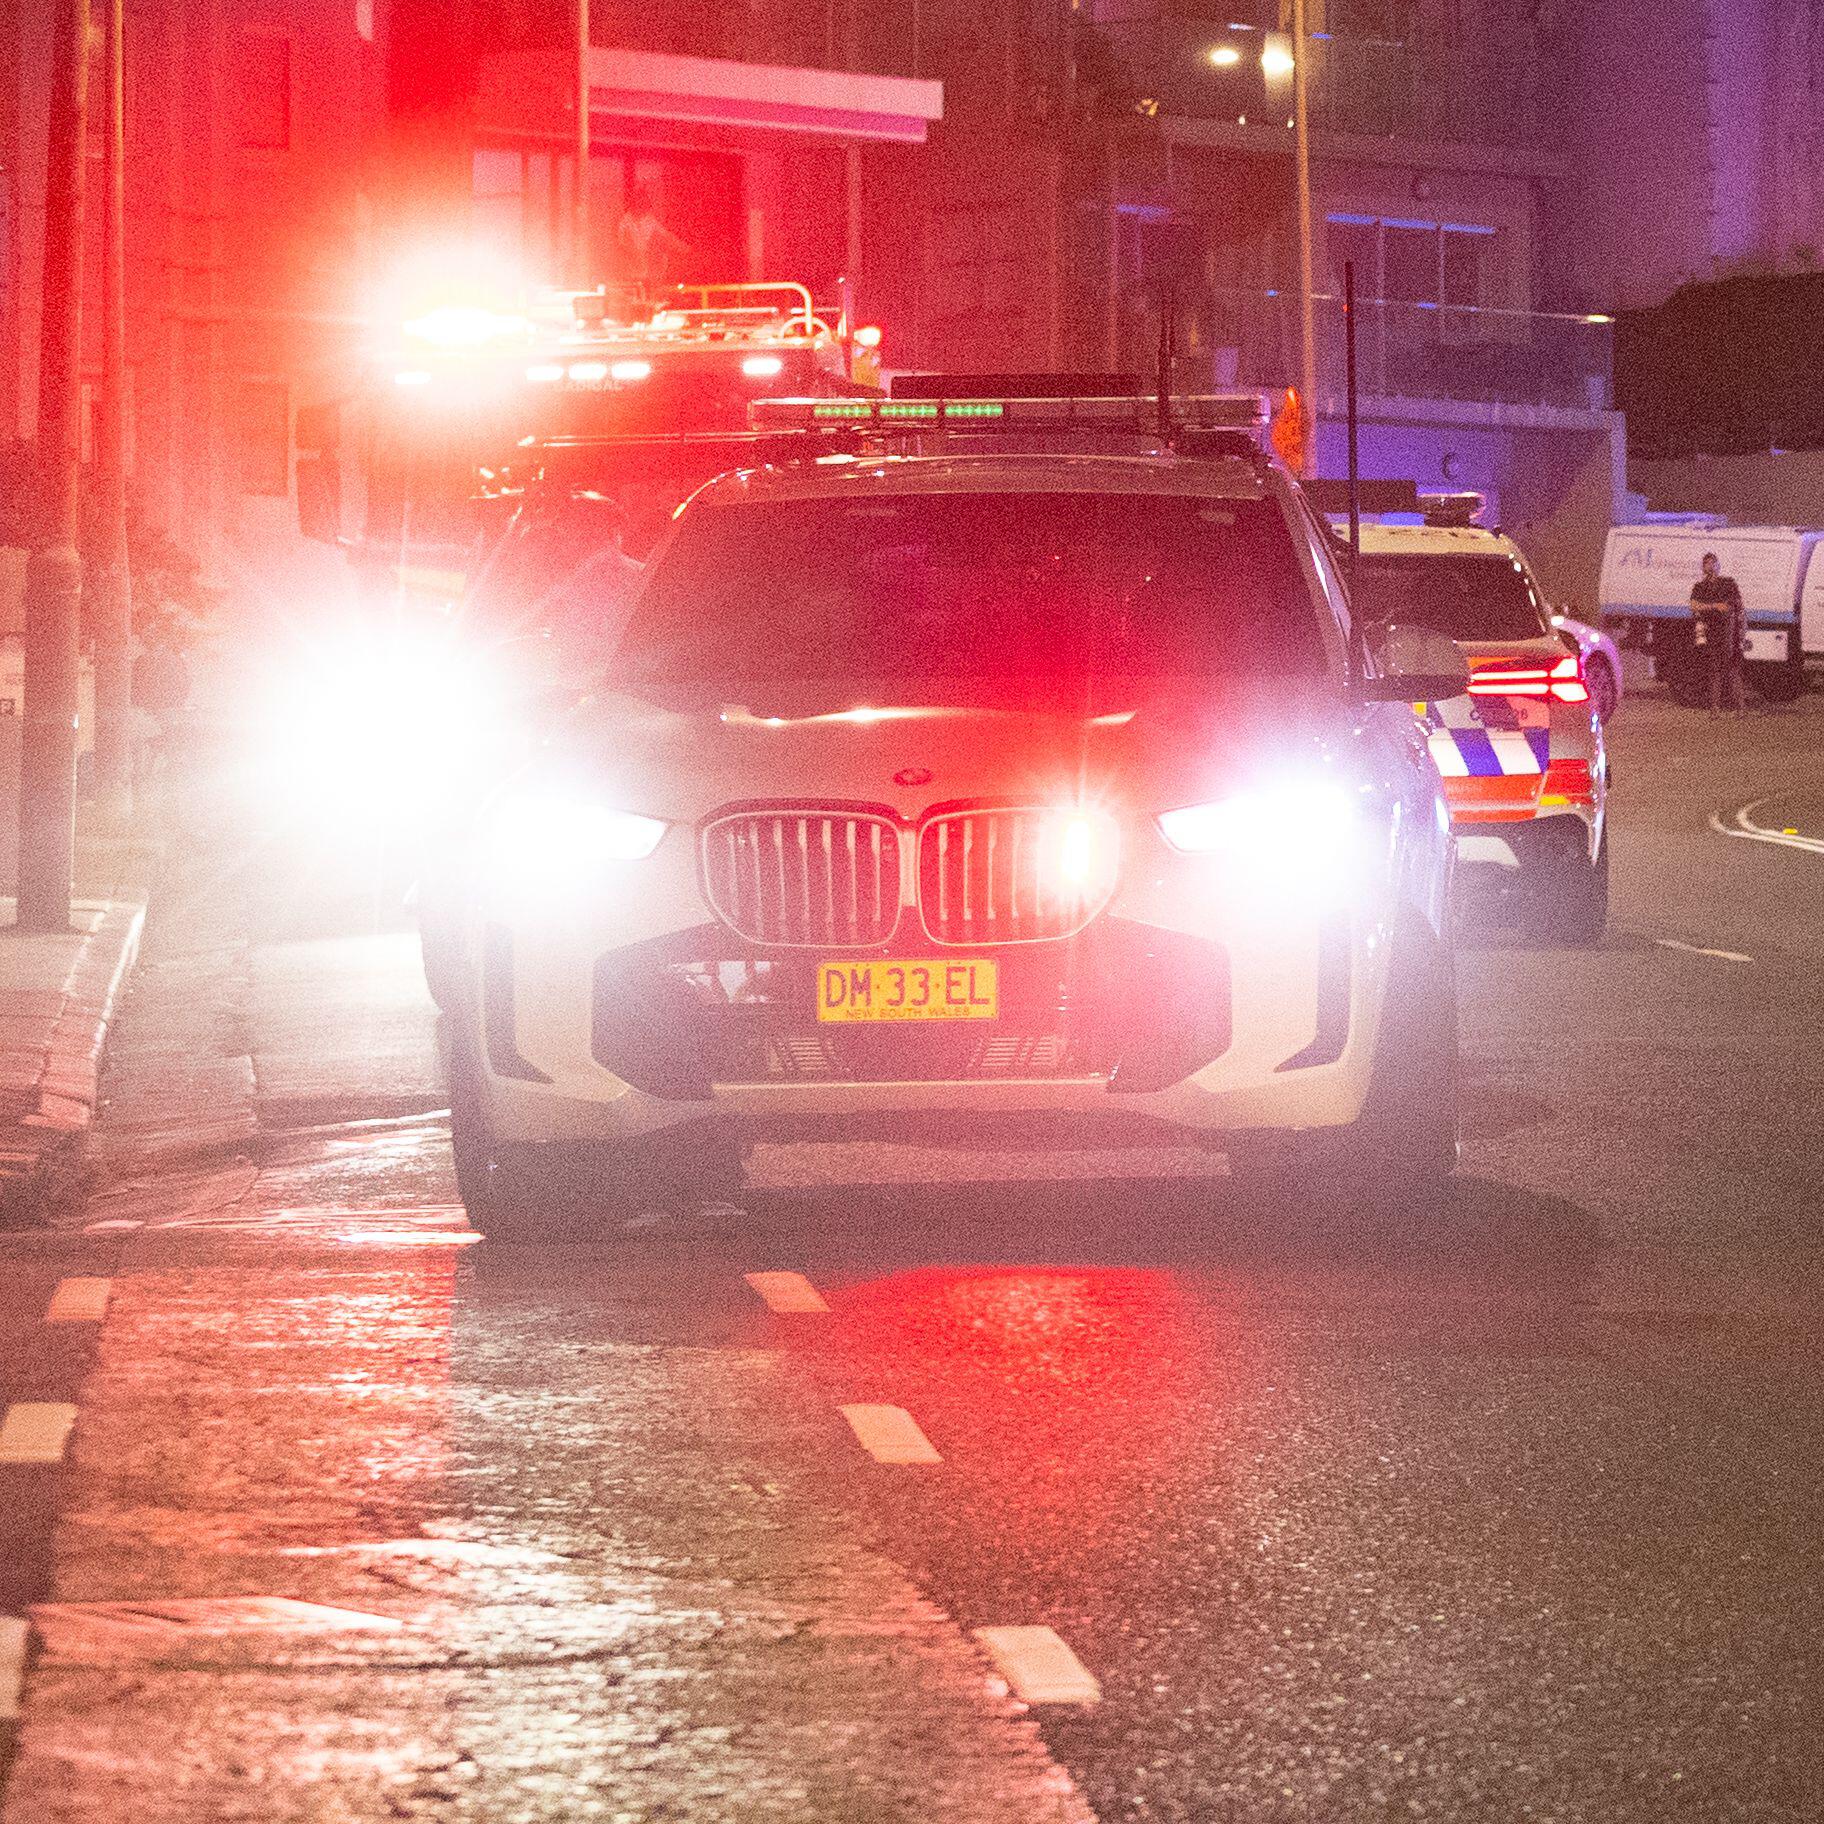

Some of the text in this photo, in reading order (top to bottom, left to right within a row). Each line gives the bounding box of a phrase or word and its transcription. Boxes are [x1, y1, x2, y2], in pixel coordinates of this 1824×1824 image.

[845, 1007, 970, 1018] NEW SOUTH WALES
